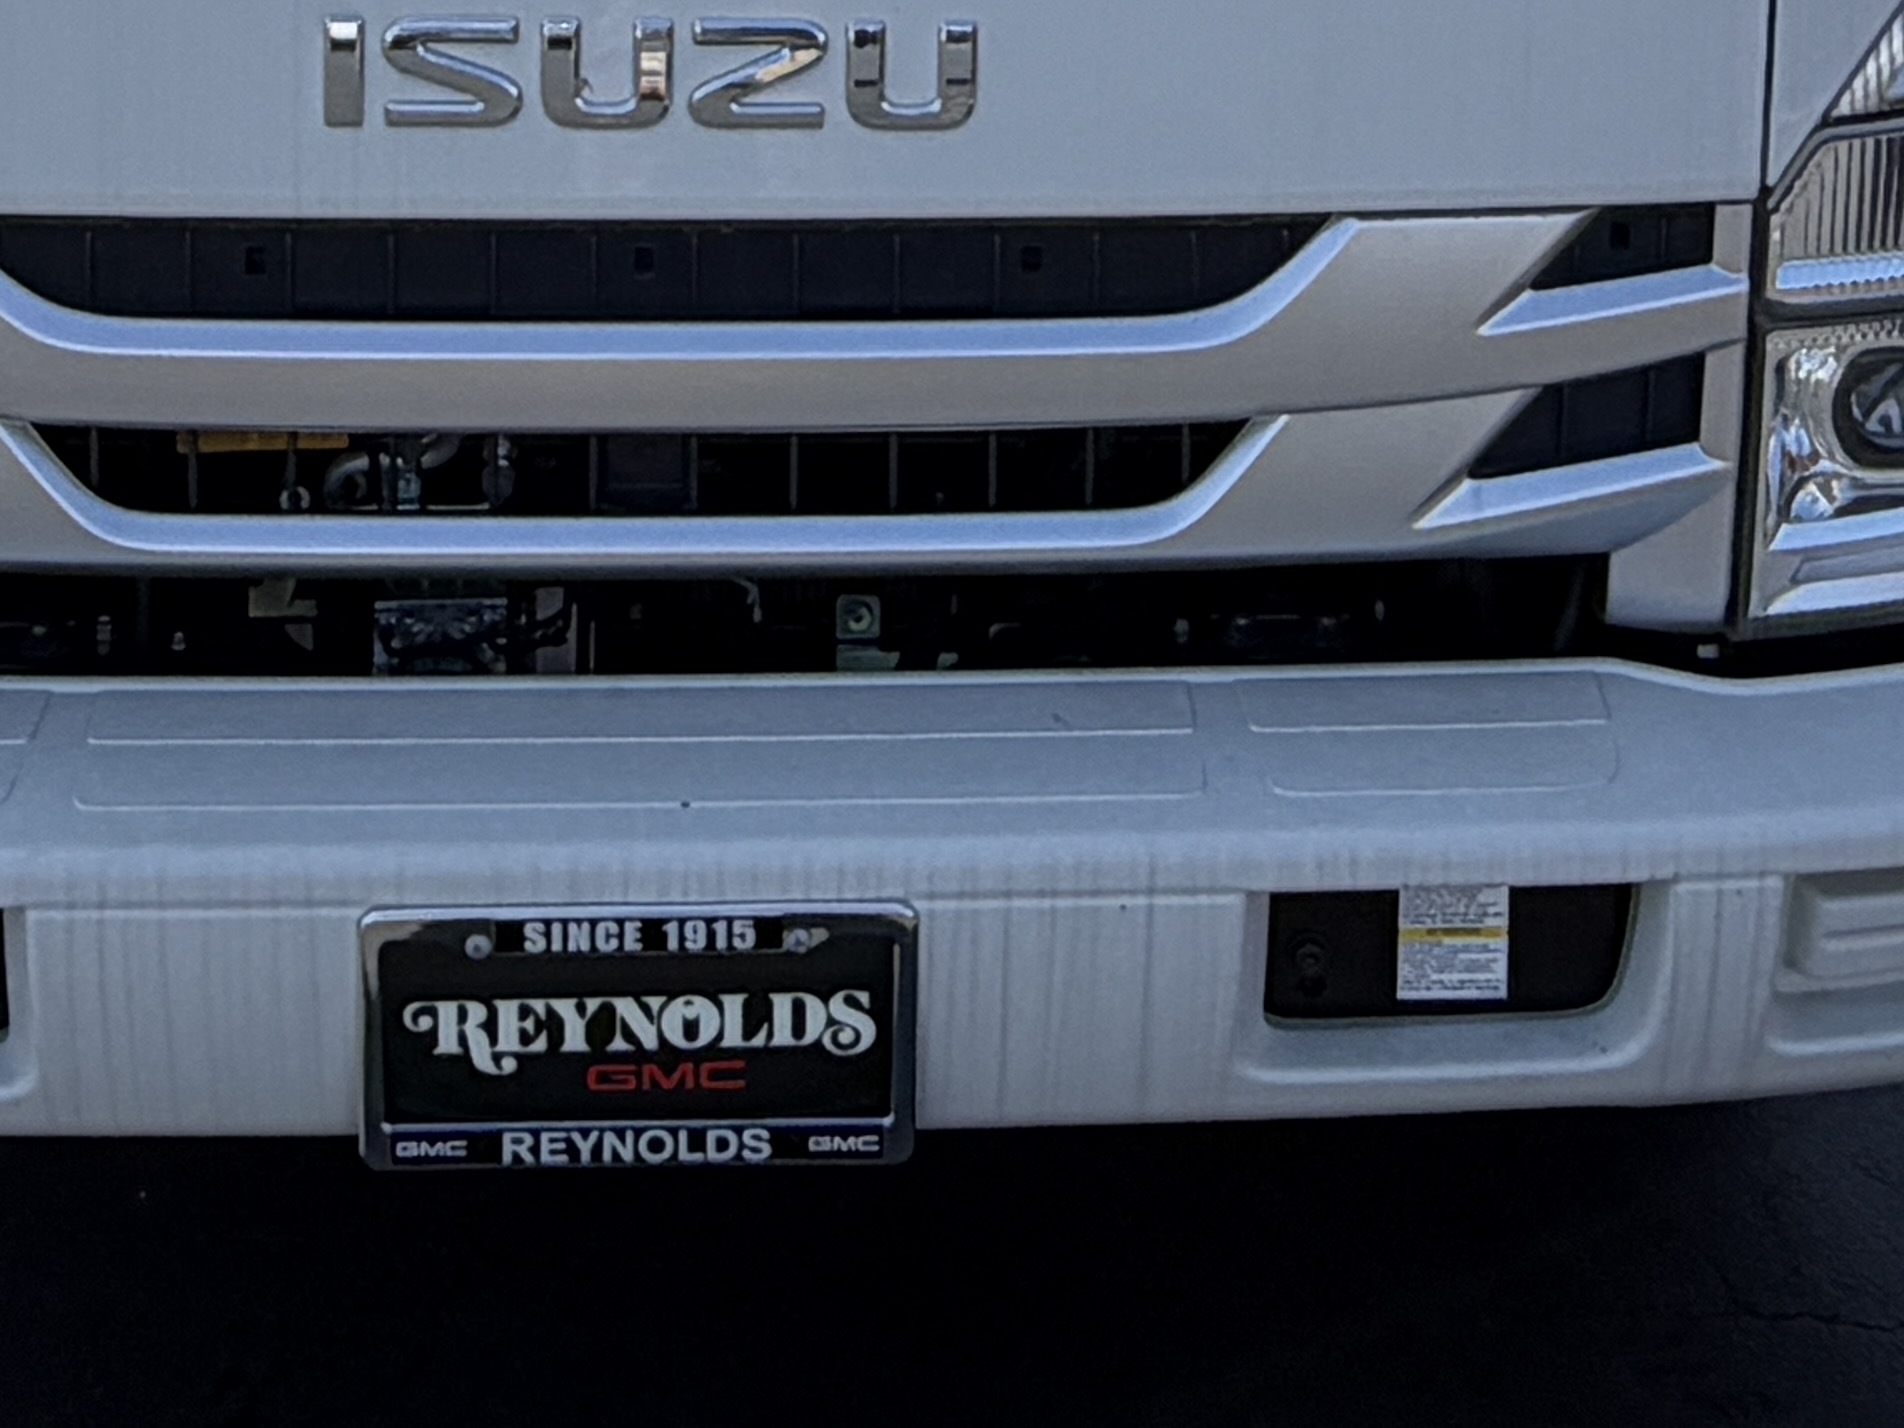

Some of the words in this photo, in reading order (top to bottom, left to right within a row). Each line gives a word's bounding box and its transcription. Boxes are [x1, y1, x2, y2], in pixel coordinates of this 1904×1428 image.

[323, 13, 979, 129] ISUZU
[523, 921, 643, 952] SINCE
[661, 919, 757, 951] 1915
[403, 990, 877, 1076] REYNOLDS
[586, 1059, 747, 1092] GMC
[395, 1140, 468, 1158] GMC
[502, 1128, 772, 1165] REYNOLDS
[808, 1135, 880, 1154] GMC
